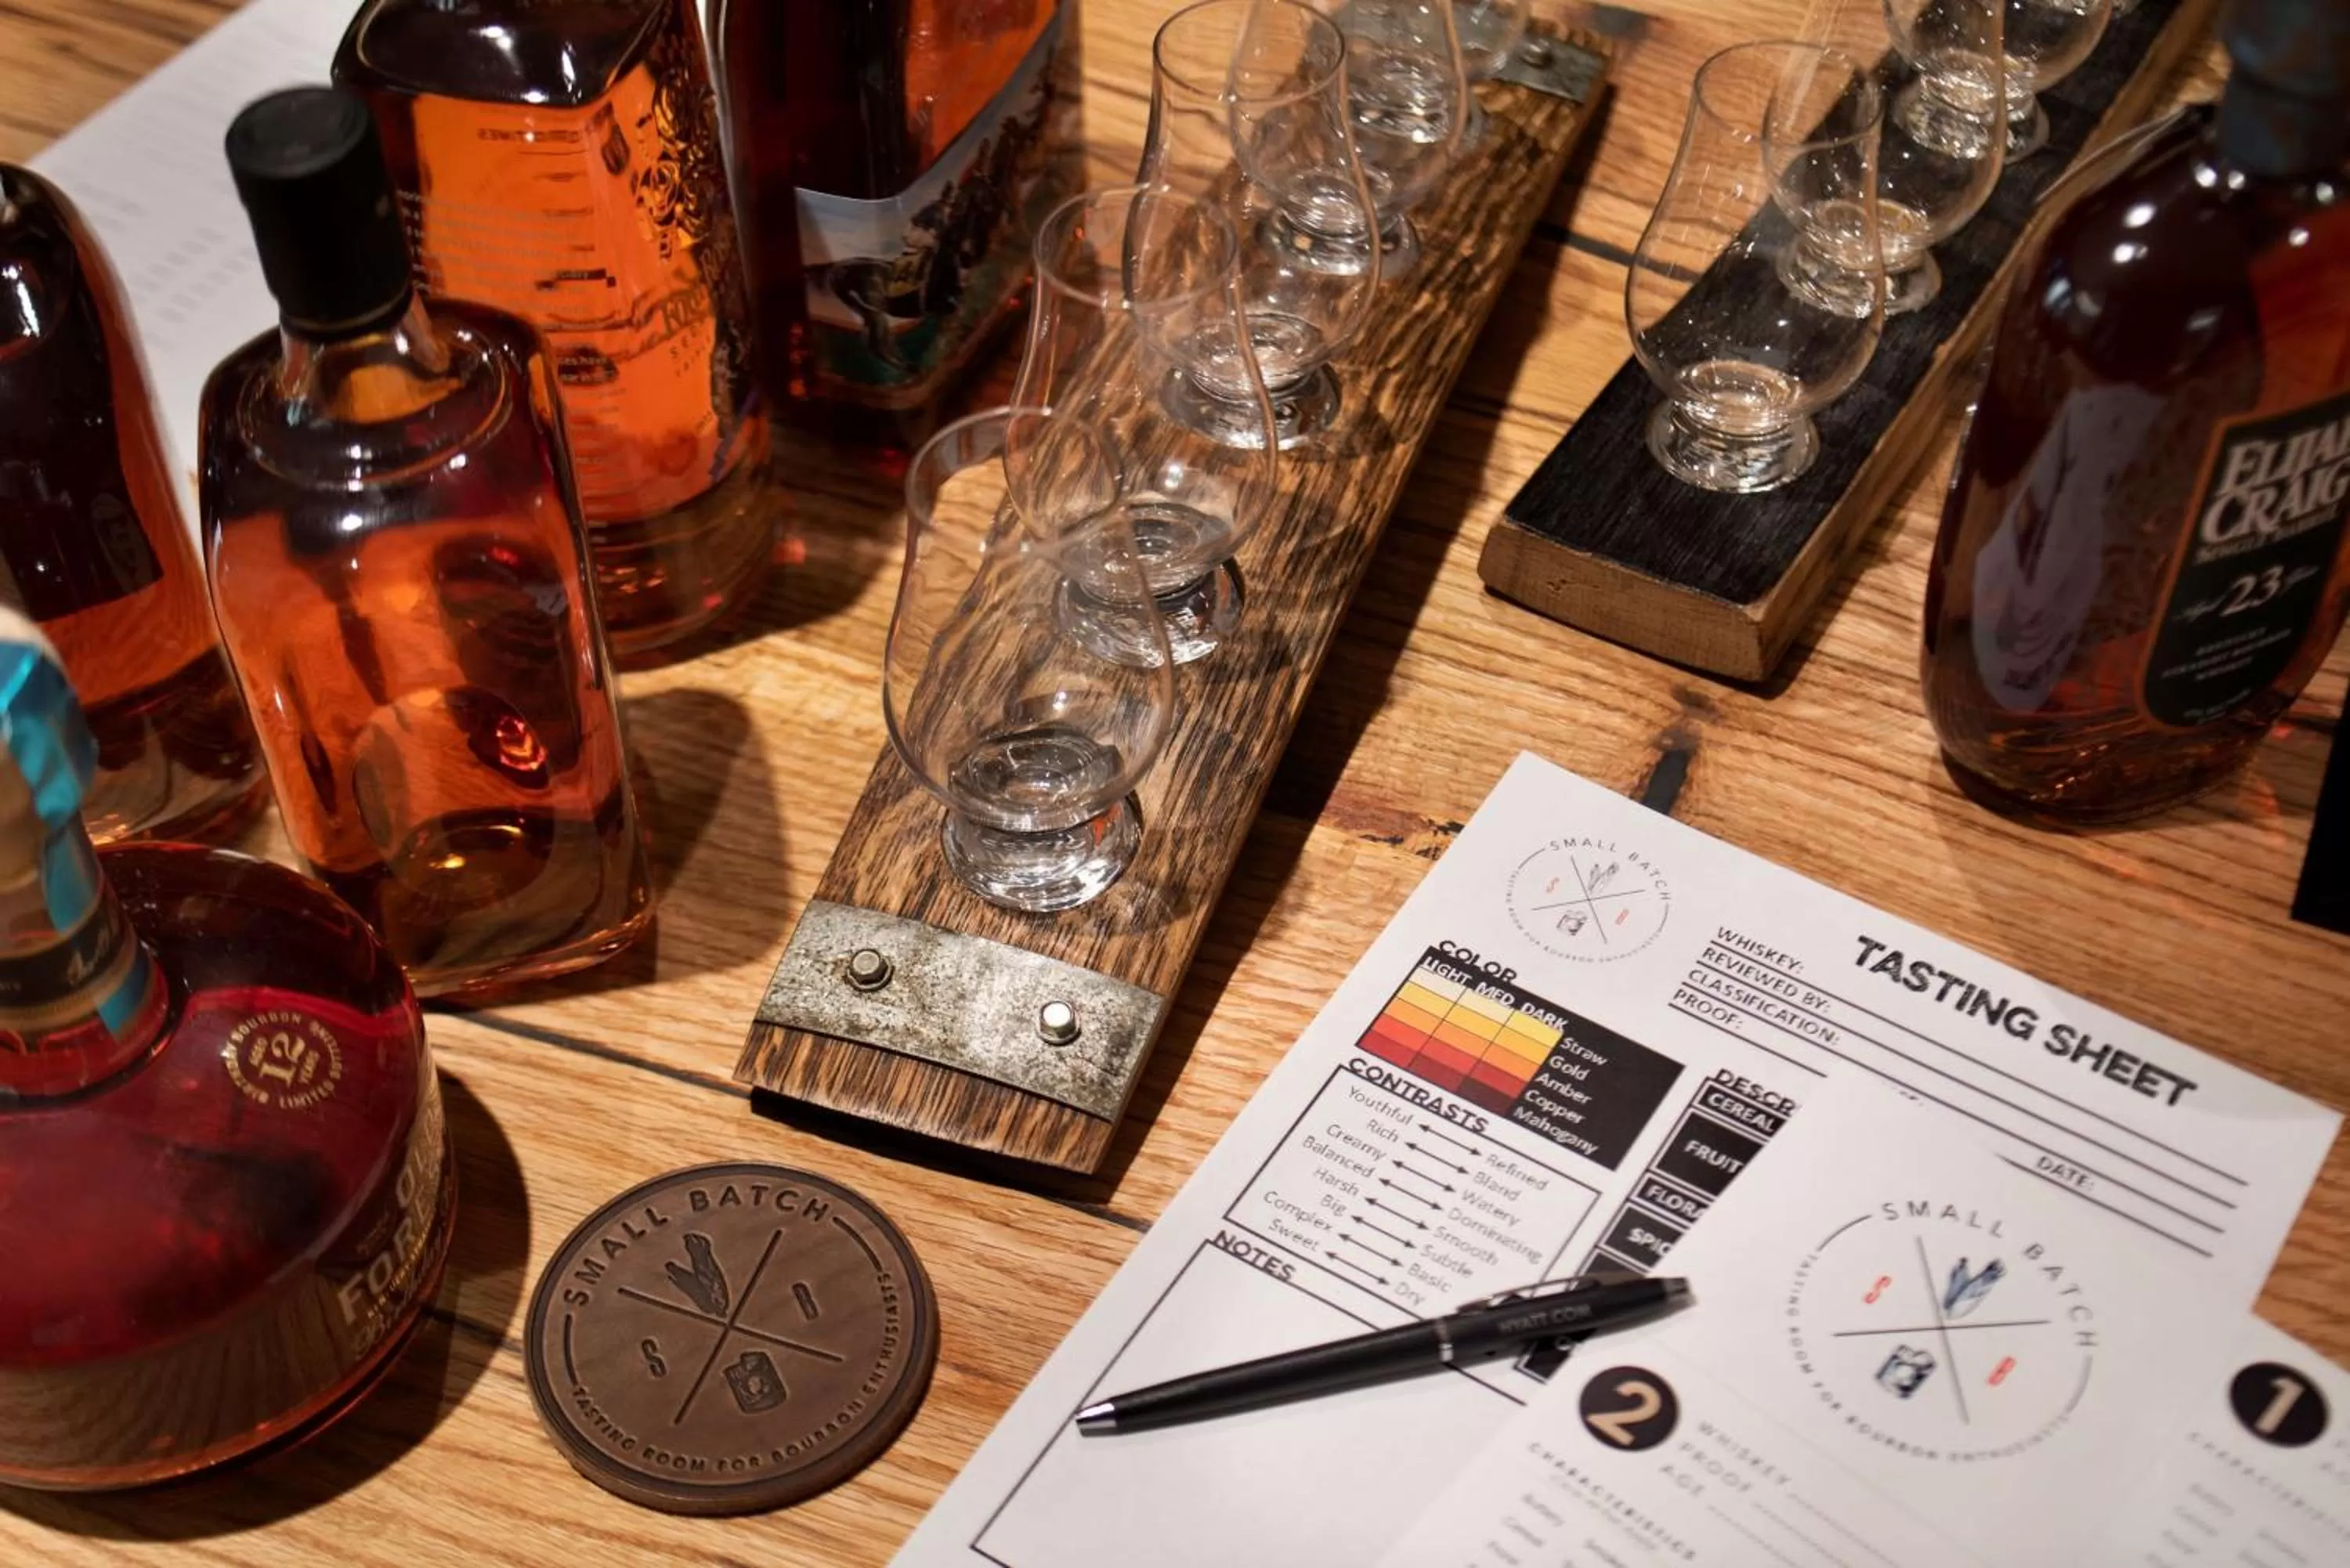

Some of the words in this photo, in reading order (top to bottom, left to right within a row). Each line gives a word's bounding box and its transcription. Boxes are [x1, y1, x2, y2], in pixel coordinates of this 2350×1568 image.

[2200, 457, 2350, 545] CRAIG
[2219, 565, 2285, 616] 23
[1549, 836, 1618, 853] SMALL
[1627, 851, 1672, 901] BATCH
[1437, 940, 1518, 985] COLOR
[1701, 946, 1799, 998] REVIEWED
[1802, 992, 1831, 1013] BY:
[1716, 927, 1804, 974] WHISKEY:
[1423, 956, 1473, 987] LIGHT
[1520, 1003, 1571, 1033] DARK
[1672, 988, 1744, 1030] PROOF:
[1687, 968, 1841, 1046] CLASSIFICATION:
[1854, 934, 2041, 1042] TASTING
[2042, 1023, 2199, 1107] SHEET
[257, 1030, 307, 1089] 12
[1548, 1054, 1593, 1082] Gold
[1560, 1036, 1610, 1067] Straw
[1348, 1057, 1489, 1134] CONTRASTS
[1523, 1088, 1588, 1127] Copper
[1533, 1071, 1593, 1105] Amber
[1706, 1093, 1777, 1133] CEREAL
[1347, 1085, 1415, 1126] Youthful
[1486, 1154, 1549, 1192] Refined
[1365, 1118, 1400, 1143] Rich
[1473, 1171, 1522, 1202] Bland
[1513, 1105, 1600, 1157] Mahogany
[1684, 1140, 1744, 1174] FRUIT
[1302, 1135, 1376, 1180] Balanced
[1448, 1205, 1546, 1266] Dominating
[1325, 1123, 1390, 1162] Creamy
[1462, 1189, 1522, 1228] Watery
[2035, 1154, 2095, 1191] DATE:
[563, 1206, 669, 1306] SMALL
[689, 1184, 831, 1223] BATCH
[1263, 1190, 1333, 1234] Complex
[1408, 1263, 1453, 1294] Basic
[1314, 1166, 1360, 1198] Harsh
[1433, 1226, 1500, 1267] Smooth
[1319, 1194, 1348, 1217] Big
[1421, 1243, 1475, 1281] Subtle
[1211, 1230, 1297, 1283] NOTES
[1268, 1218, 1320, 1254] Sweet
[1393, 1281, 1426, 1307] Dry
[1881, 1200, 2005, 1239] SMALL
[2021, 1241, 2099, 1349] BATCH
[571, 1385, 638, 1451] TASTING
[642, 1445, 707, 1472] ROOM
[716, 1454, 761, 1473] FOR
[771, 1399, 865, 1464] BOURBON
[860, 1271, 900, 1396] ENTHUSIASTS
[640, 1336, 667, 1379] S
[1585, 1380, 1661, 1447] 2
[2254, 1375, 2307, 1434] 1
